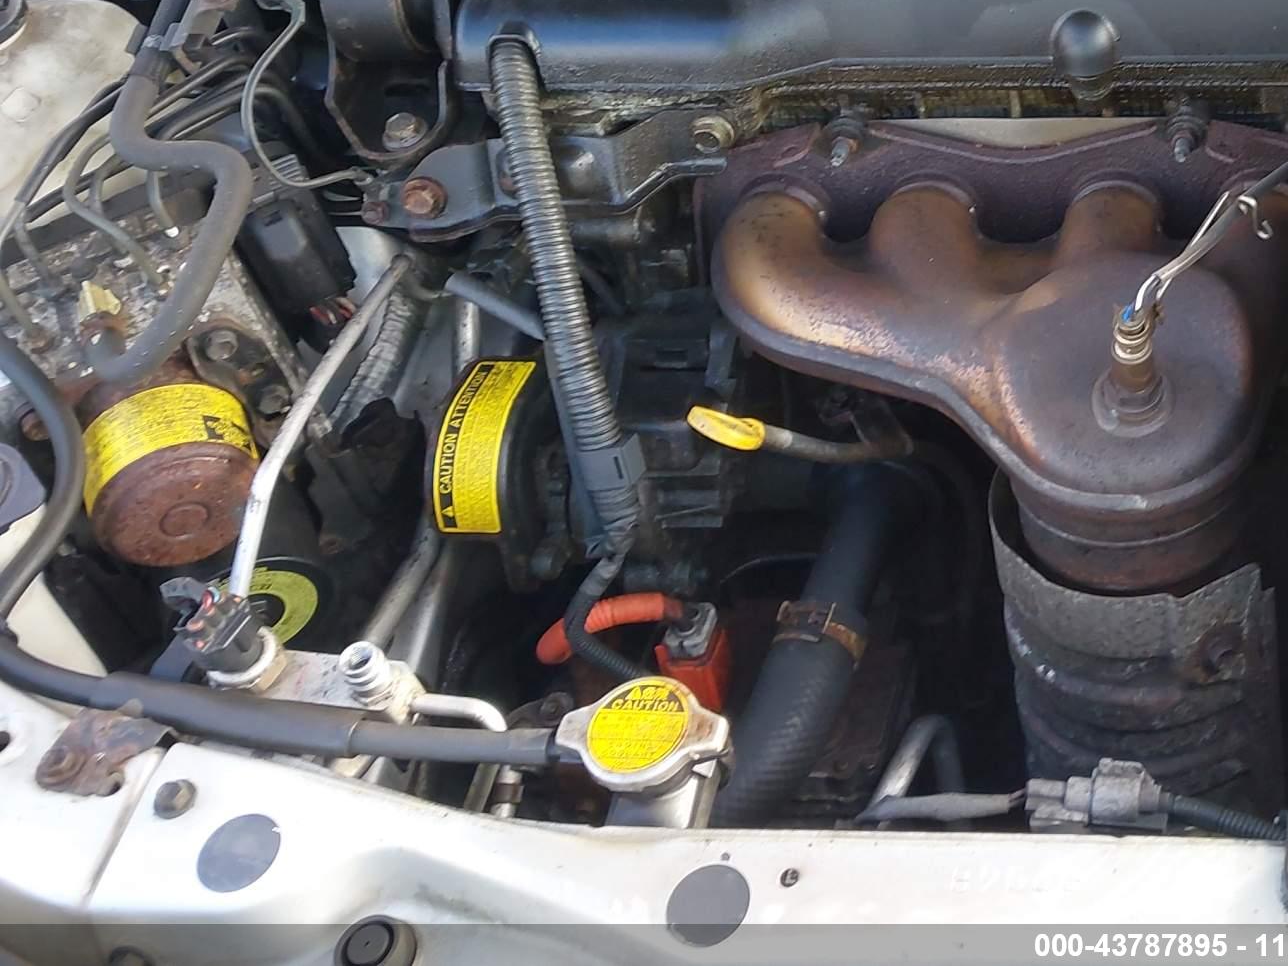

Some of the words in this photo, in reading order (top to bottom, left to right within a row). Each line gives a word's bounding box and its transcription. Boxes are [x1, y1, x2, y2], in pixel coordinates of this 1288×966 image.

[439, 433, 458, 495] CAUTION
[450, 371, 488, 428] ATTENTION
[611, 698, 679, 711] CAUTION
